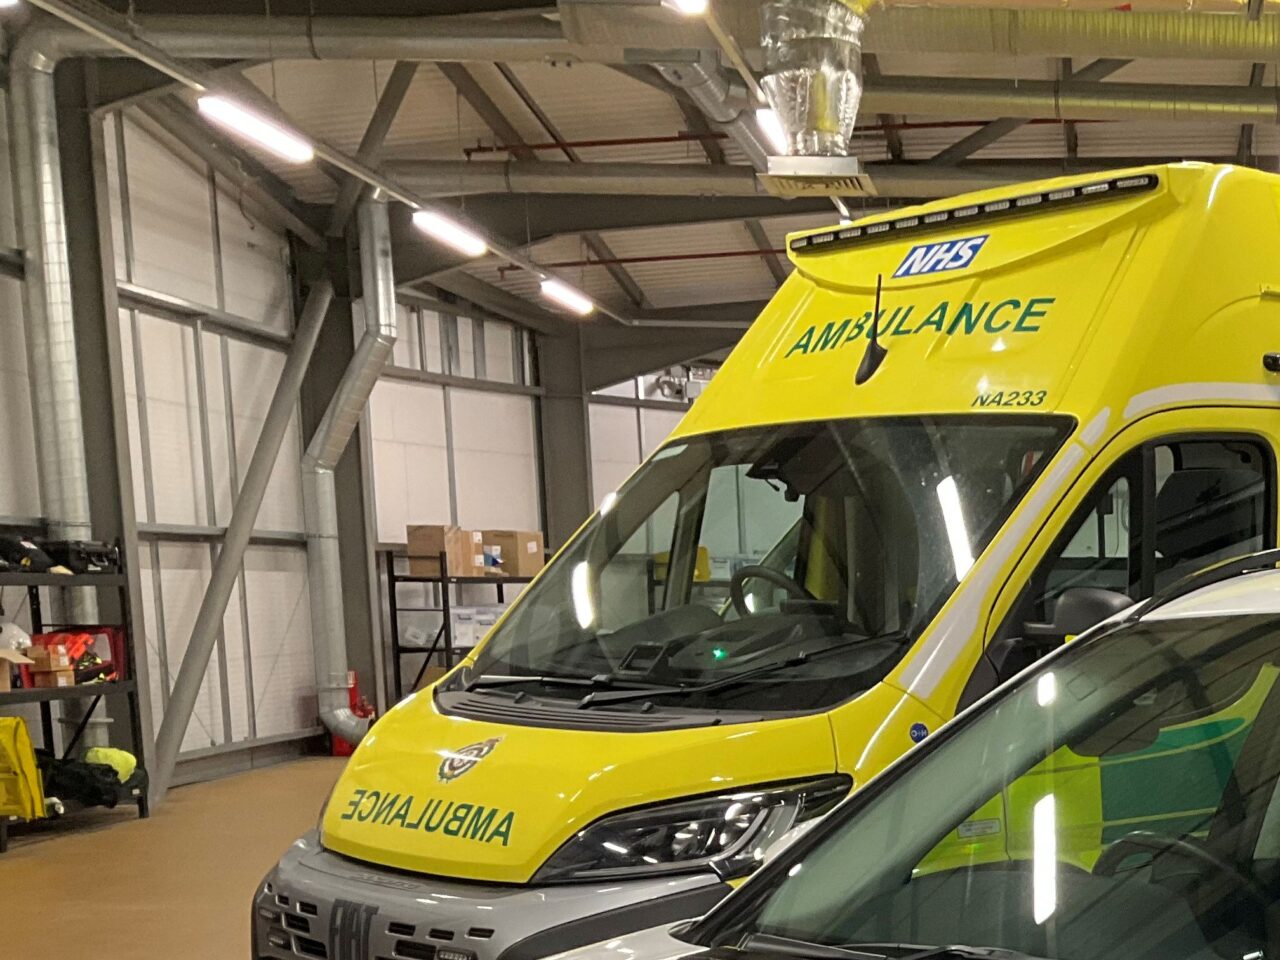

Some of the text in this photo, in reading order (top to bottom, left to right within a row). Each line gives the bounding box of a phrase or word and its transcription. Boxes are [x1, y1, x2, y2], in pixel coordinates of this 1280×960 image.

[895, 238, 982, 276] NHS
[785, 297, 1056, 358] AMBULANCE
[971, 390, 1048, 407] NA233
